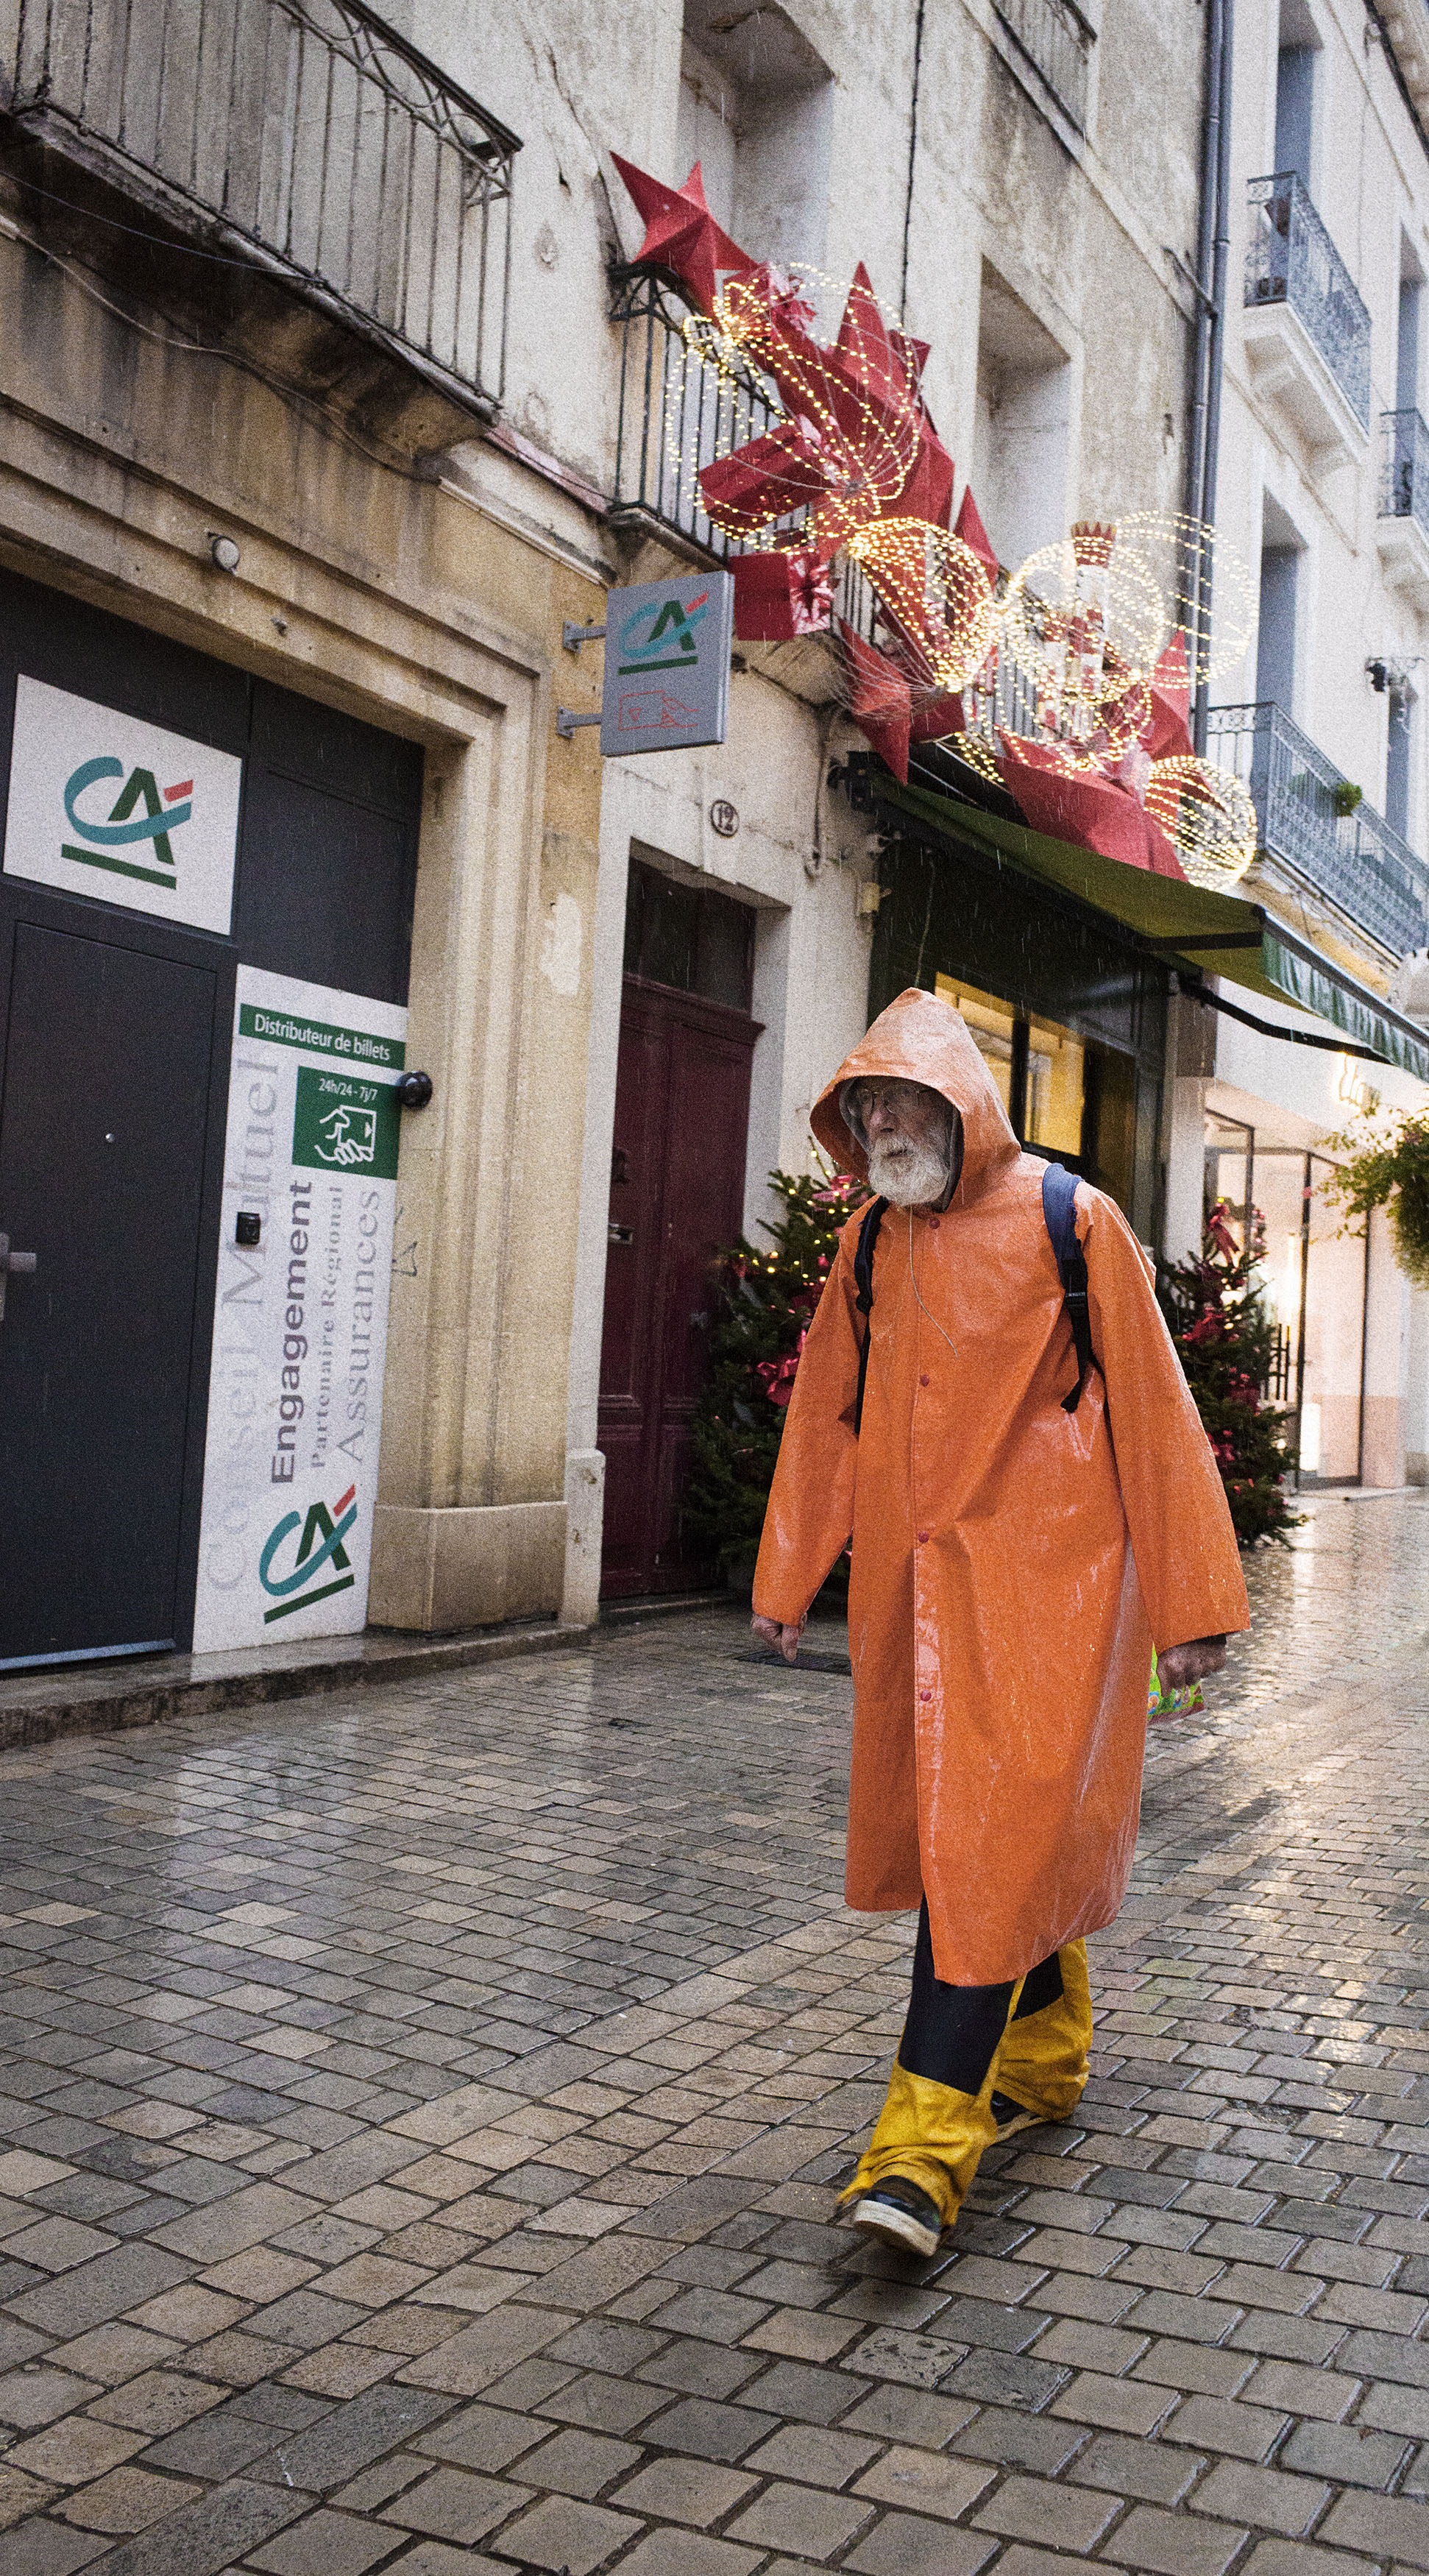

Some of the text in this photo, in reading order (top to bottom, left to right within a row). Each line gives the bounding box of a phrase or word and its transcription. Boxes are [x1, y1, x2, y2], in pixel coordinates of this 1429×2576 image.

[717, 804, 734, 832] 12
[254, 1013, 391, 1061] Distributeur de billets
[318, 1078, 352, 1096] 24h/24
[271, 1180, 313, 1484] Engagement
[336, 1190, 380, 1464] Assurances
[311, 1318, 335, 1468] Partenaire
